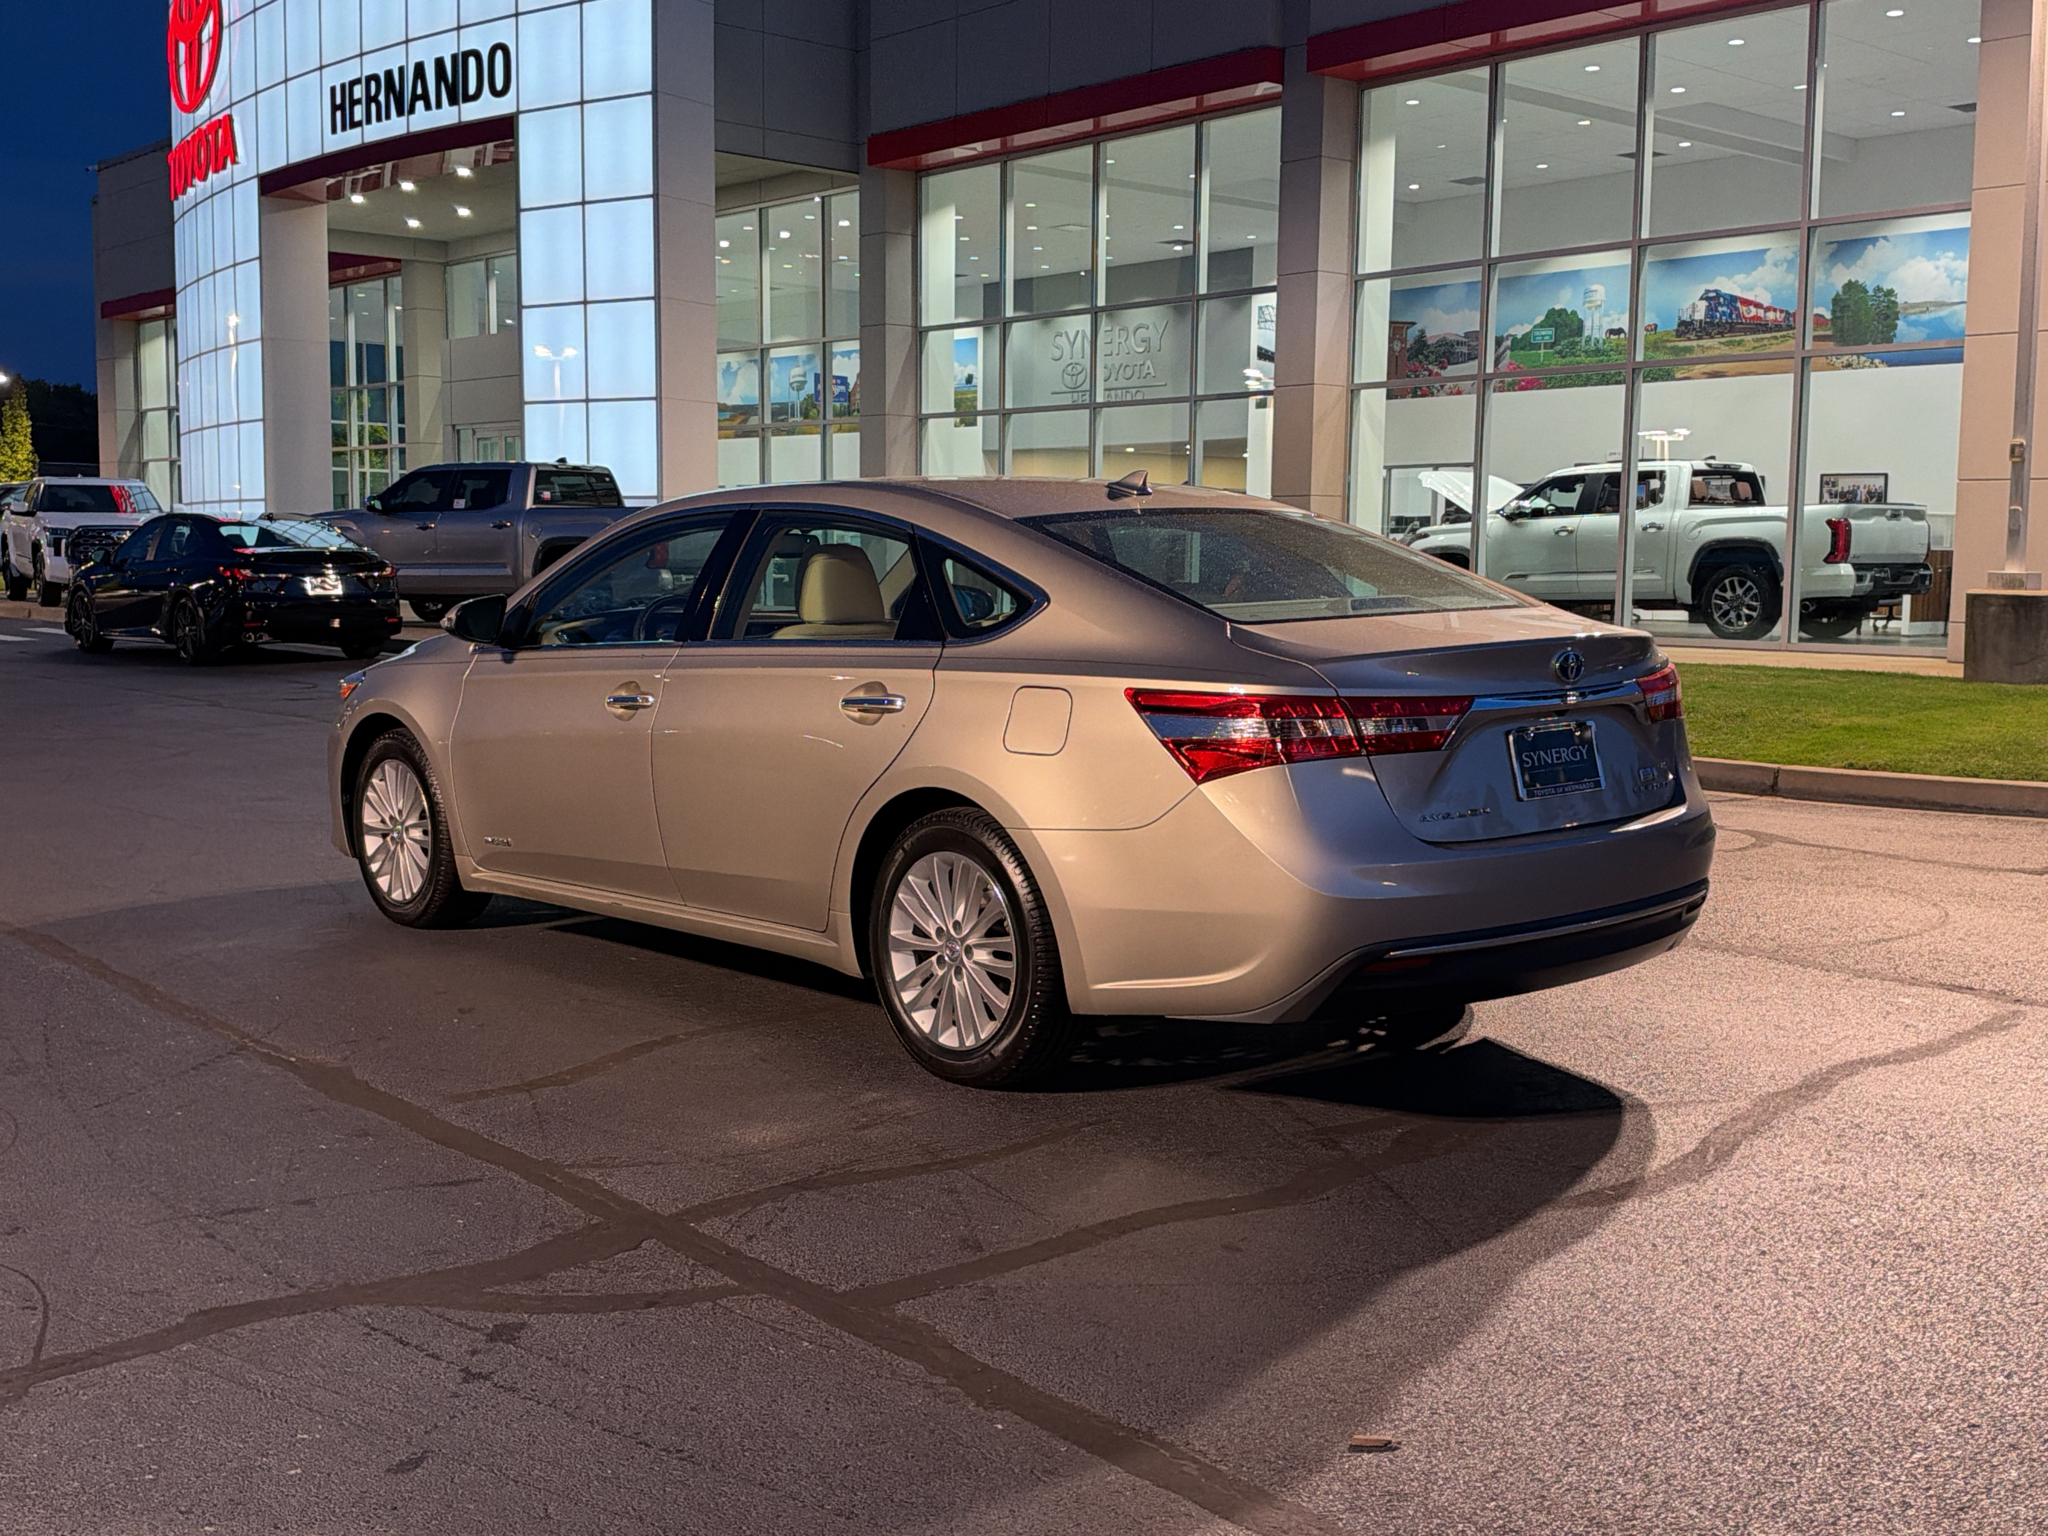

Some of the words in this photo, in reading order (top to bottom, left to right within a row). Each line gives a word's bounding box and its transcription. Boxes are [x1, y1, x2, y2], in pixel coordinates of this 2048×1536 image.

[329, 42, 512, 135] HERNANDO
[167, 112, 237, 202] TOYOTA
[1103, 360, 1156, 383] OYOTA
[1071, 390, 1145, 404] HEANDO
[1522, 744, 1589, 768] SYNERGY
[1533, 787, 1556, 797] TOYOTA
[1564, 781, 1595, 792] HERNANDO
